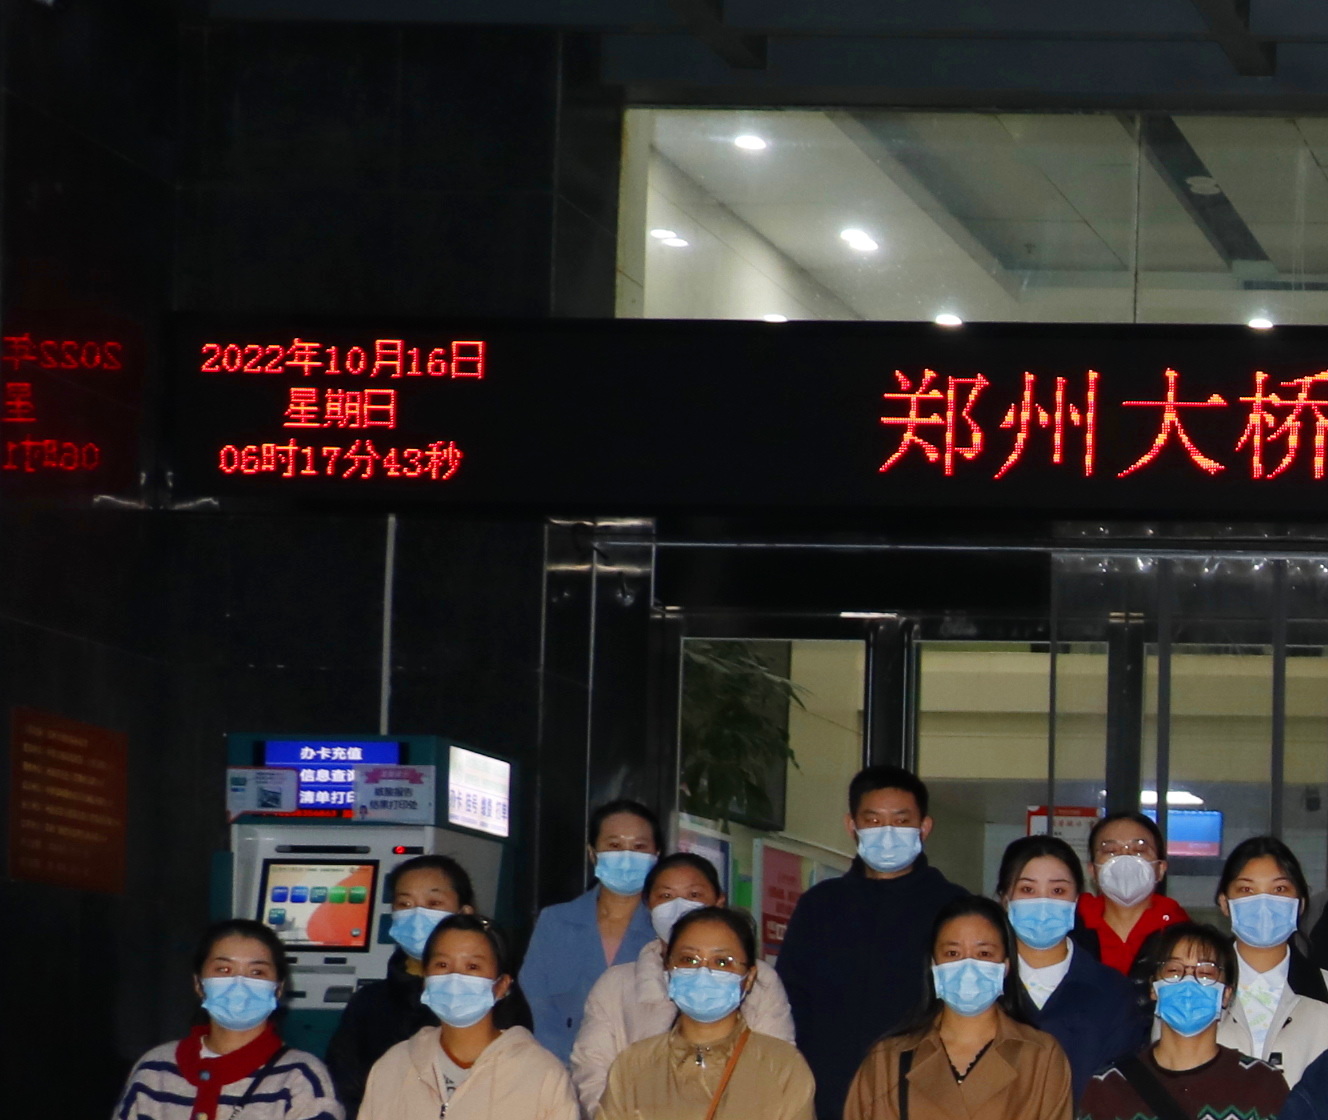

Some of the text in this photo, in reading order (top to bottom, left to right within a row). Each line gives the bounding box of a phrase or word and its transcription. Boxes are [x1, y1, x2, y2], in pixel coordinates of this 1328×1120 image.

[201, 338, 488, 381] 2022年10月16日
[283, 387, 399, 431] 星期日
[219, 438, 465, 482] 06时17分43秒
[300, 746, 362, 761] 办卡充值
